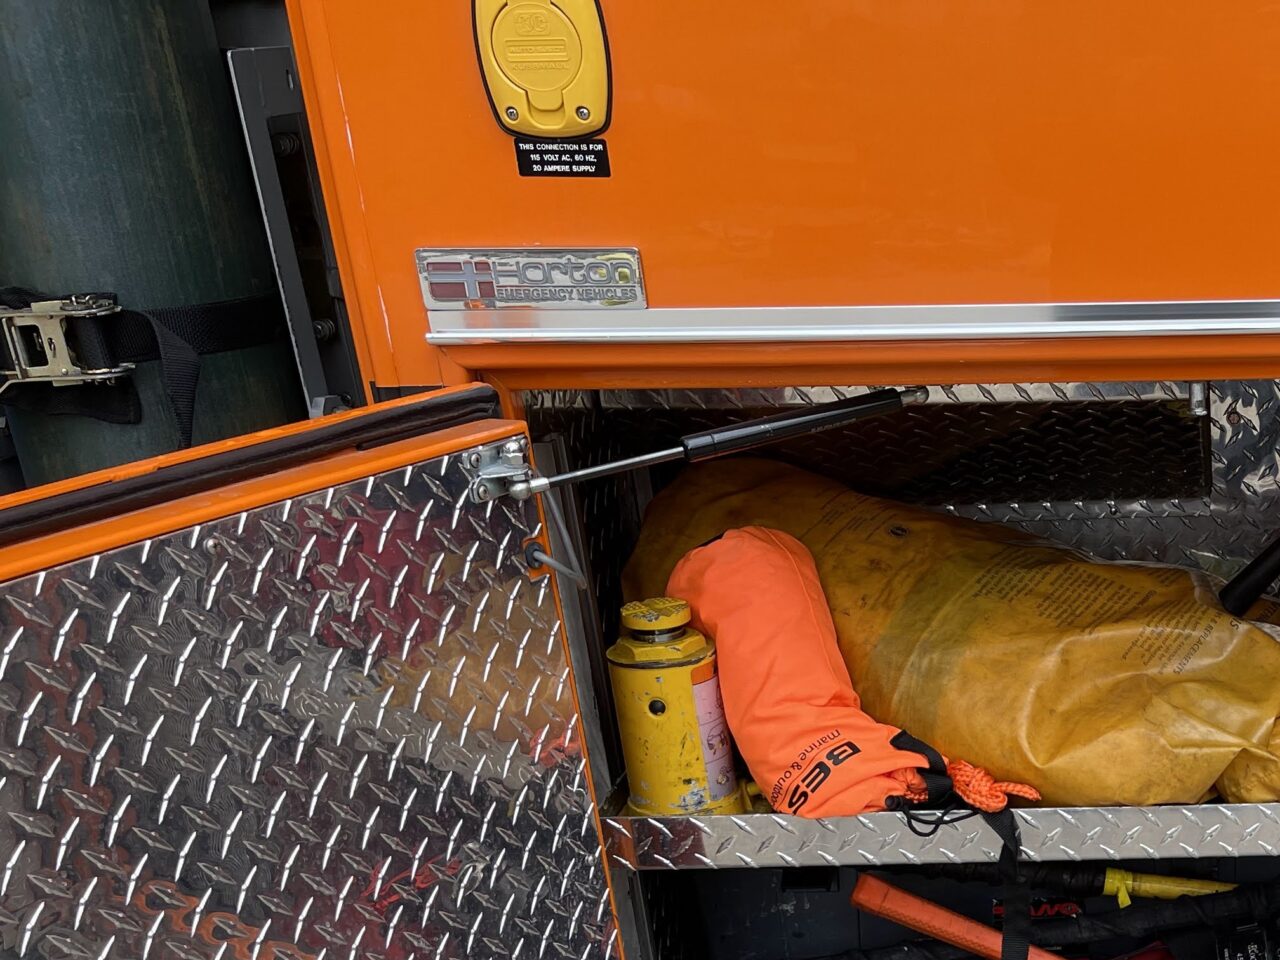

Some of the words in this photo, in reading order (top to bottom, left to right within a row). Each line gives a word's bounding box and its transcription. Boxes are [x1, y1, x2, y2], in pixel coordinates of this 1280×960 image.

[561, 154, 573, 162] AC,
[574, 154, 584, 162] 60
[494, 257, 636, 284] Horton
[496, 287, 575, 301] EMERGENCY
[576, 287, 638, 301] VEHICLES
[799, 729, 841, 760] marine
[790, 761, 802, 770] &
[788, 740, 861, 815] BES
